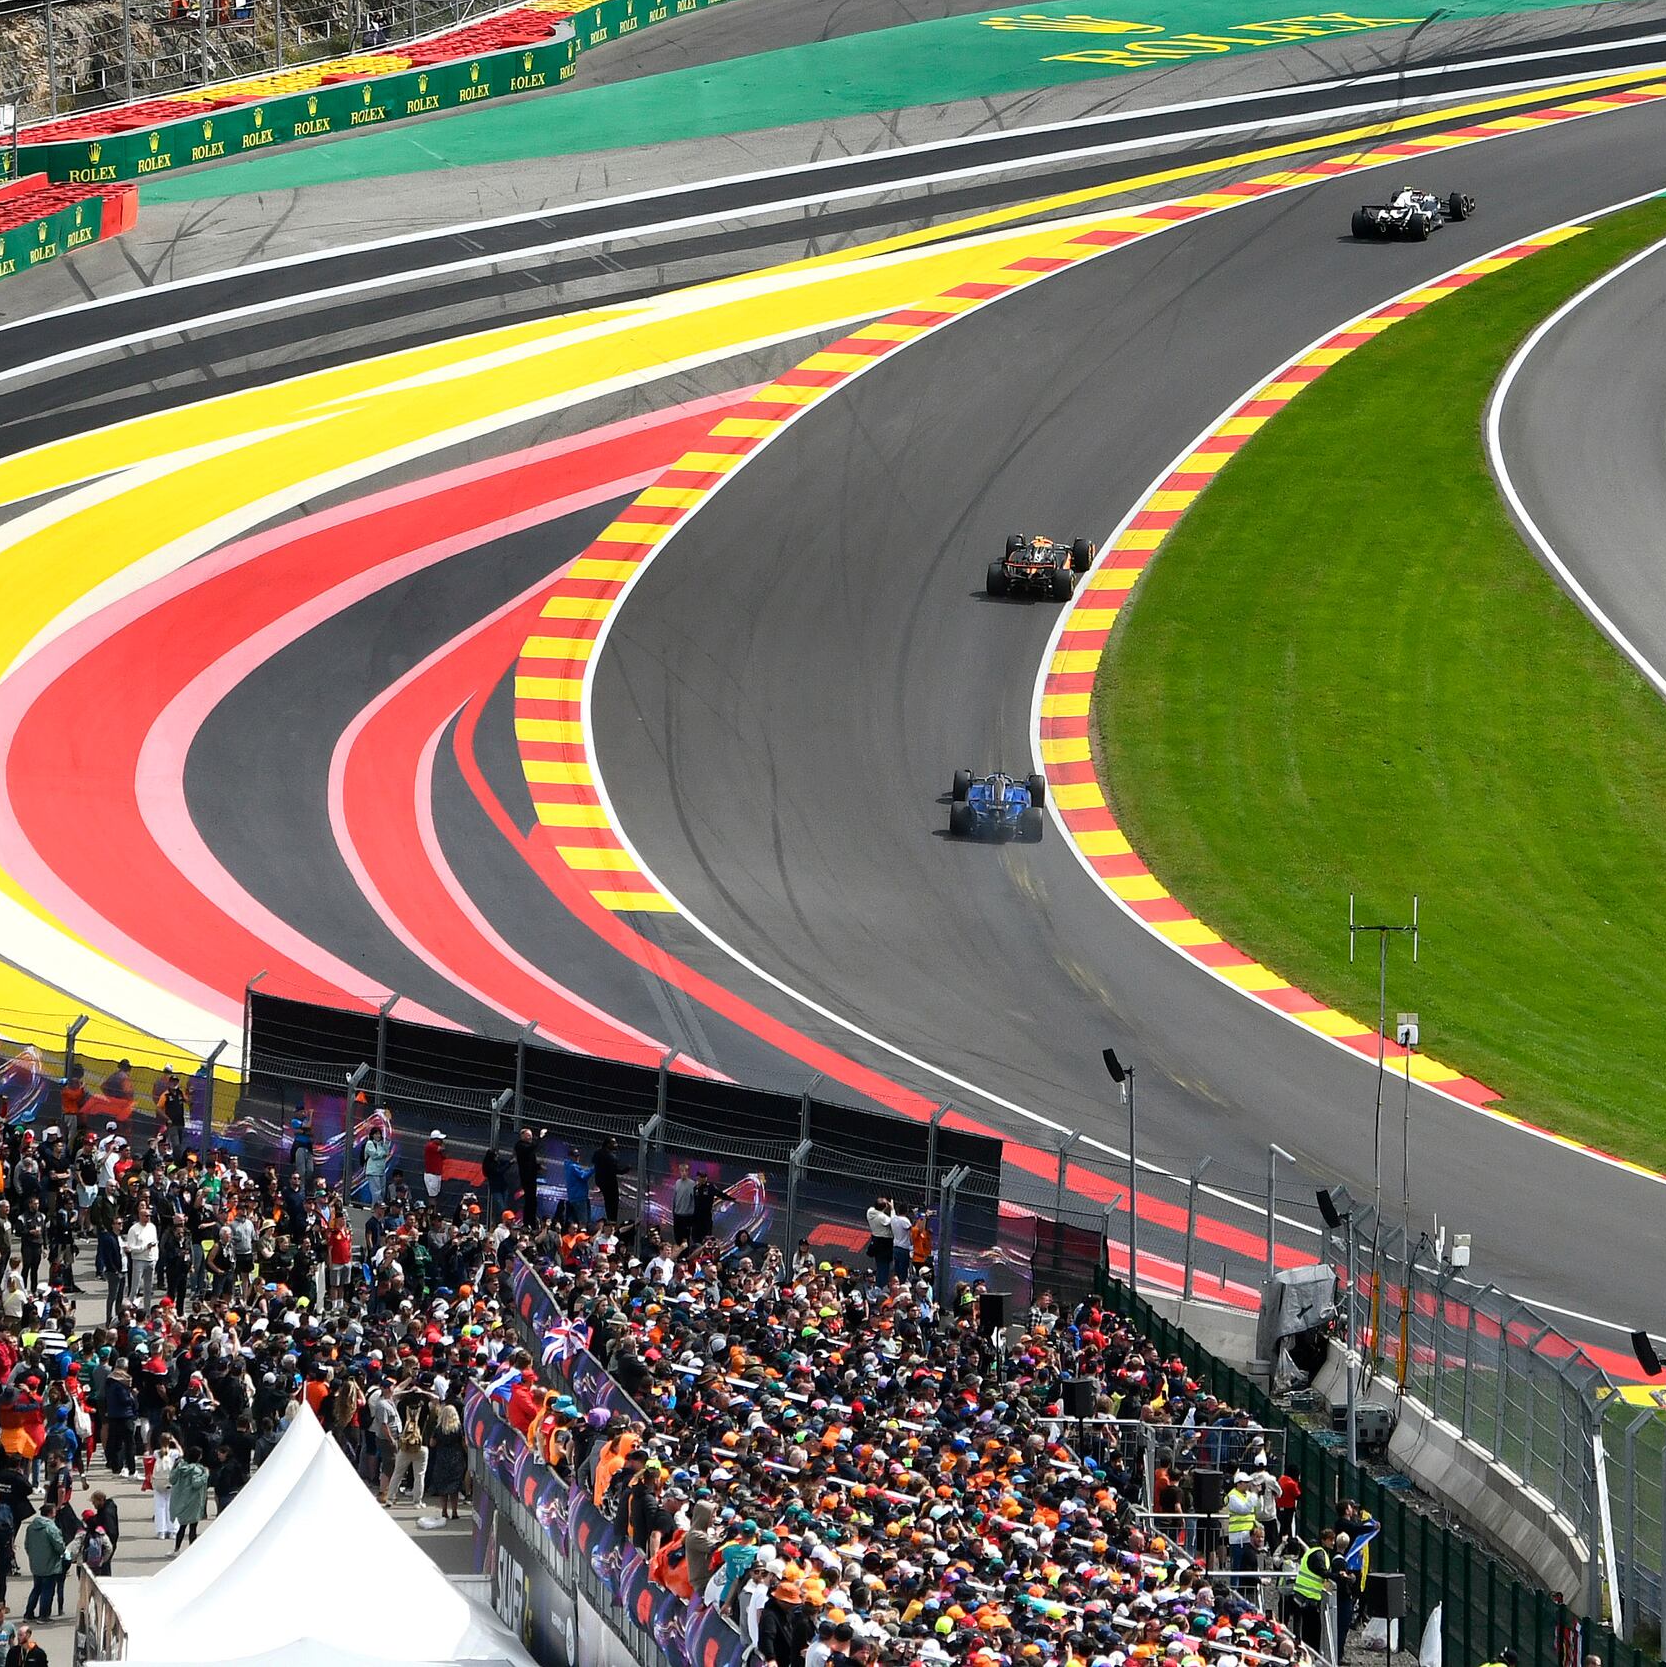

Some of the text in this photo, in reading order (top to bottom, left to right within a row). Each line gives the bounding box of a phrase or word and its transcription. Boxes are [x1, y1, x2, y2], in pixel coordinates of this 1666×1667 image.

[1039, 13, 1427, 68] ROLEX
[511, 73, 545, 90] ROLEX
[460, 84, 489, 101] ROLEX
[407, 95, 439, 113] ROLEX
[351, 106, 385, 124] ROLEX
[295, 118, 330, 136] ROLEX
[243, 129, 273, 148] ROLEX
[192, 142, 224, 160] ROLEX
[138, 154, 171, 173] ROLEX
[69, 166, 116, 182] ROLEX
[67, 227, 92, 247] ROLEX
[30, 243, 56, 263] ROLEX
